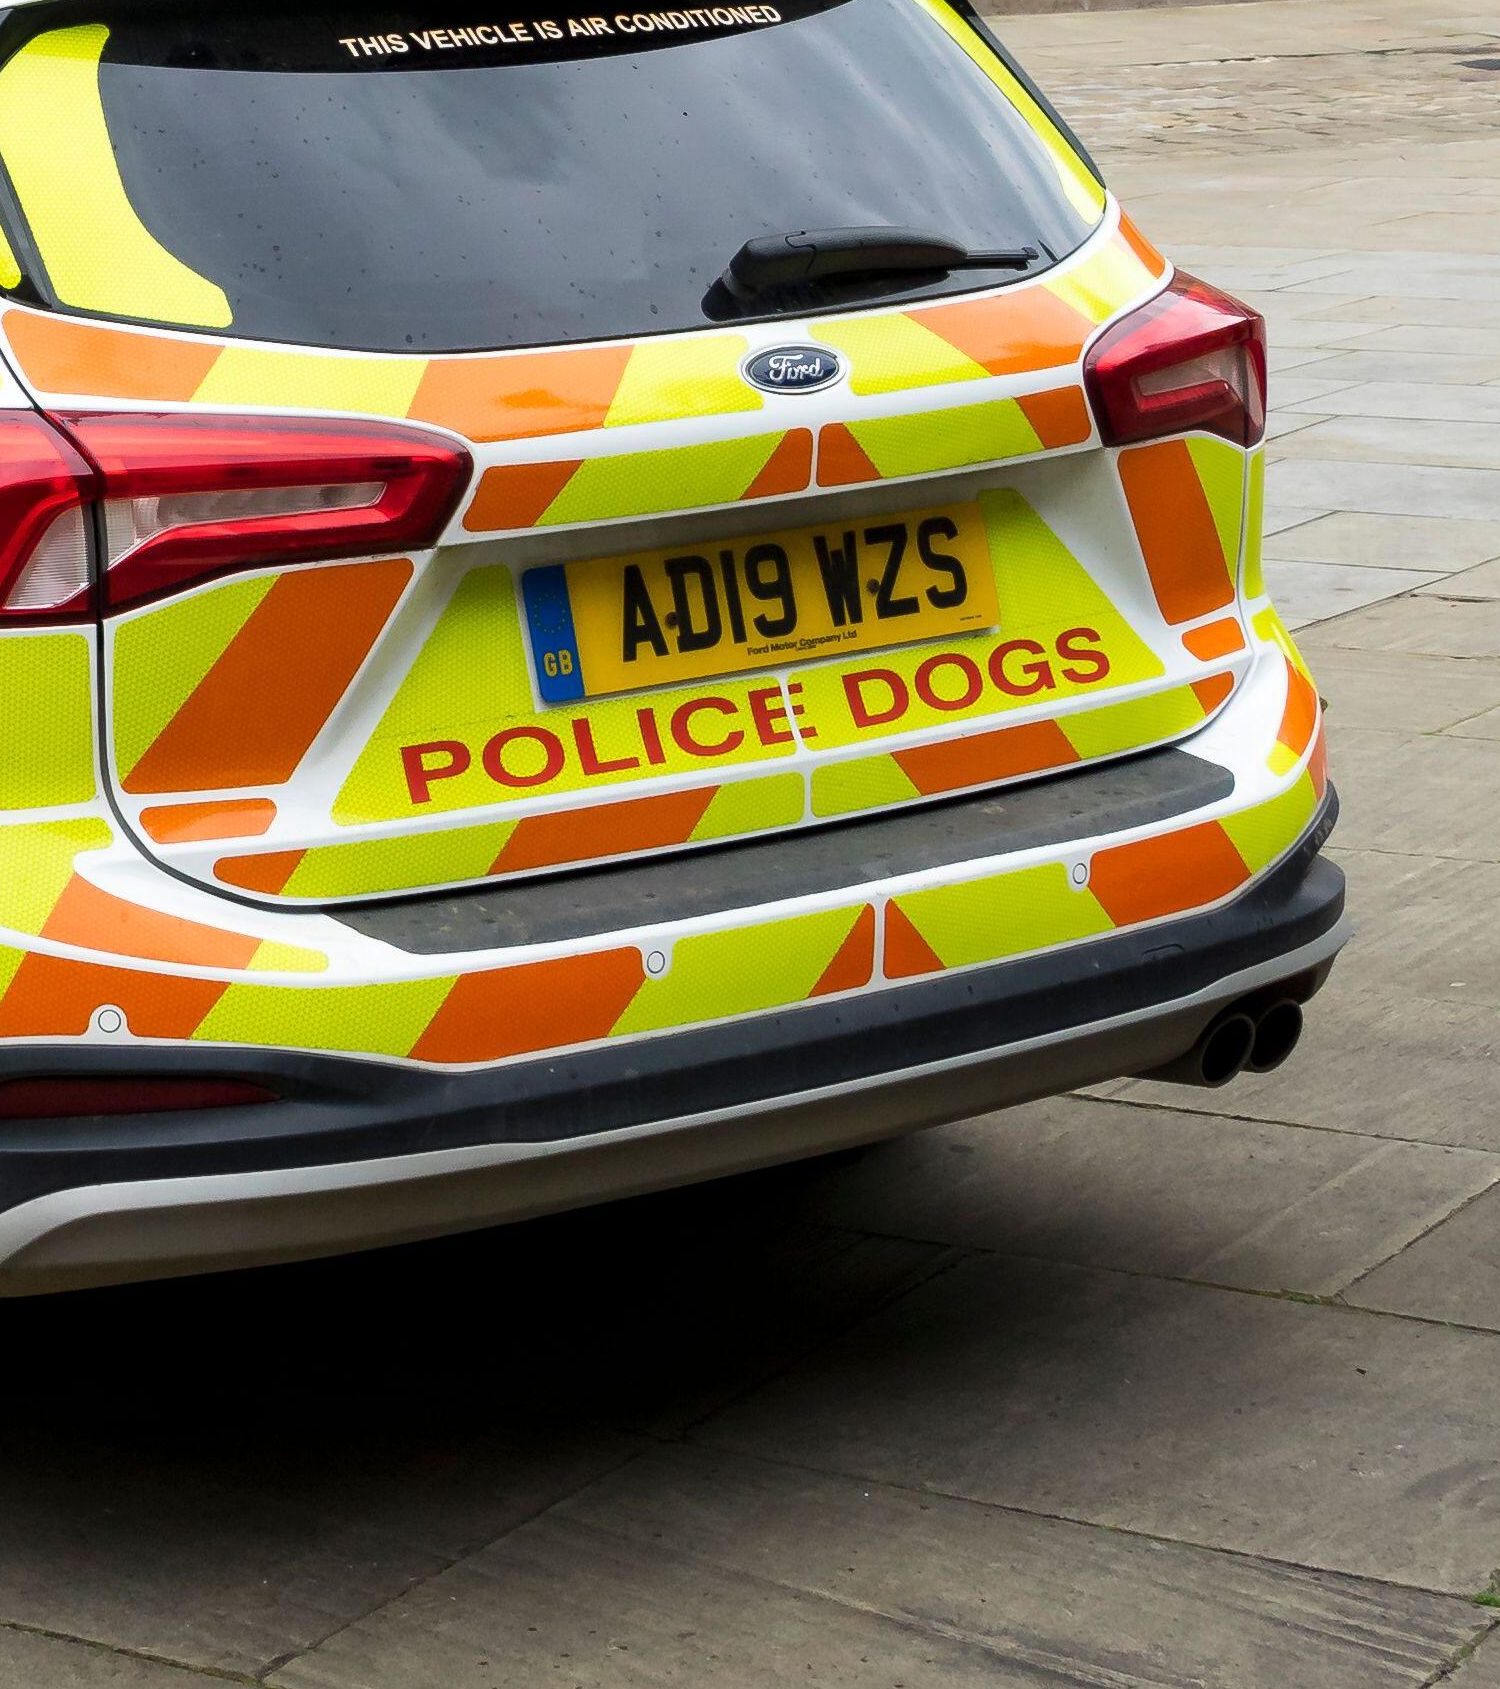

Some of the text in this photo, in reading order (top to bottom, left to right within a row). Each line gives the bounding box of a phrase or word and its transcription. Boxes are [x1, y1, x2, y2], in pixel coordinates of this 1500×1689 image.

[339, 5, 782, 57] THIS VEHICLE IS AIR CONDITIONED
[768, 353, 824, 383] Ford
[622, 515, 968, 662] AD19 WZS
[543, 649, 573, 677] GB
[747, 645, 770, 656] Ford
[770, 639, 798, 653] Motor
[799, 632, 842, 648] Company
[842, 629, 858, 640] Ltd
[400, 626, 1112, 804] POLICE DOGS
